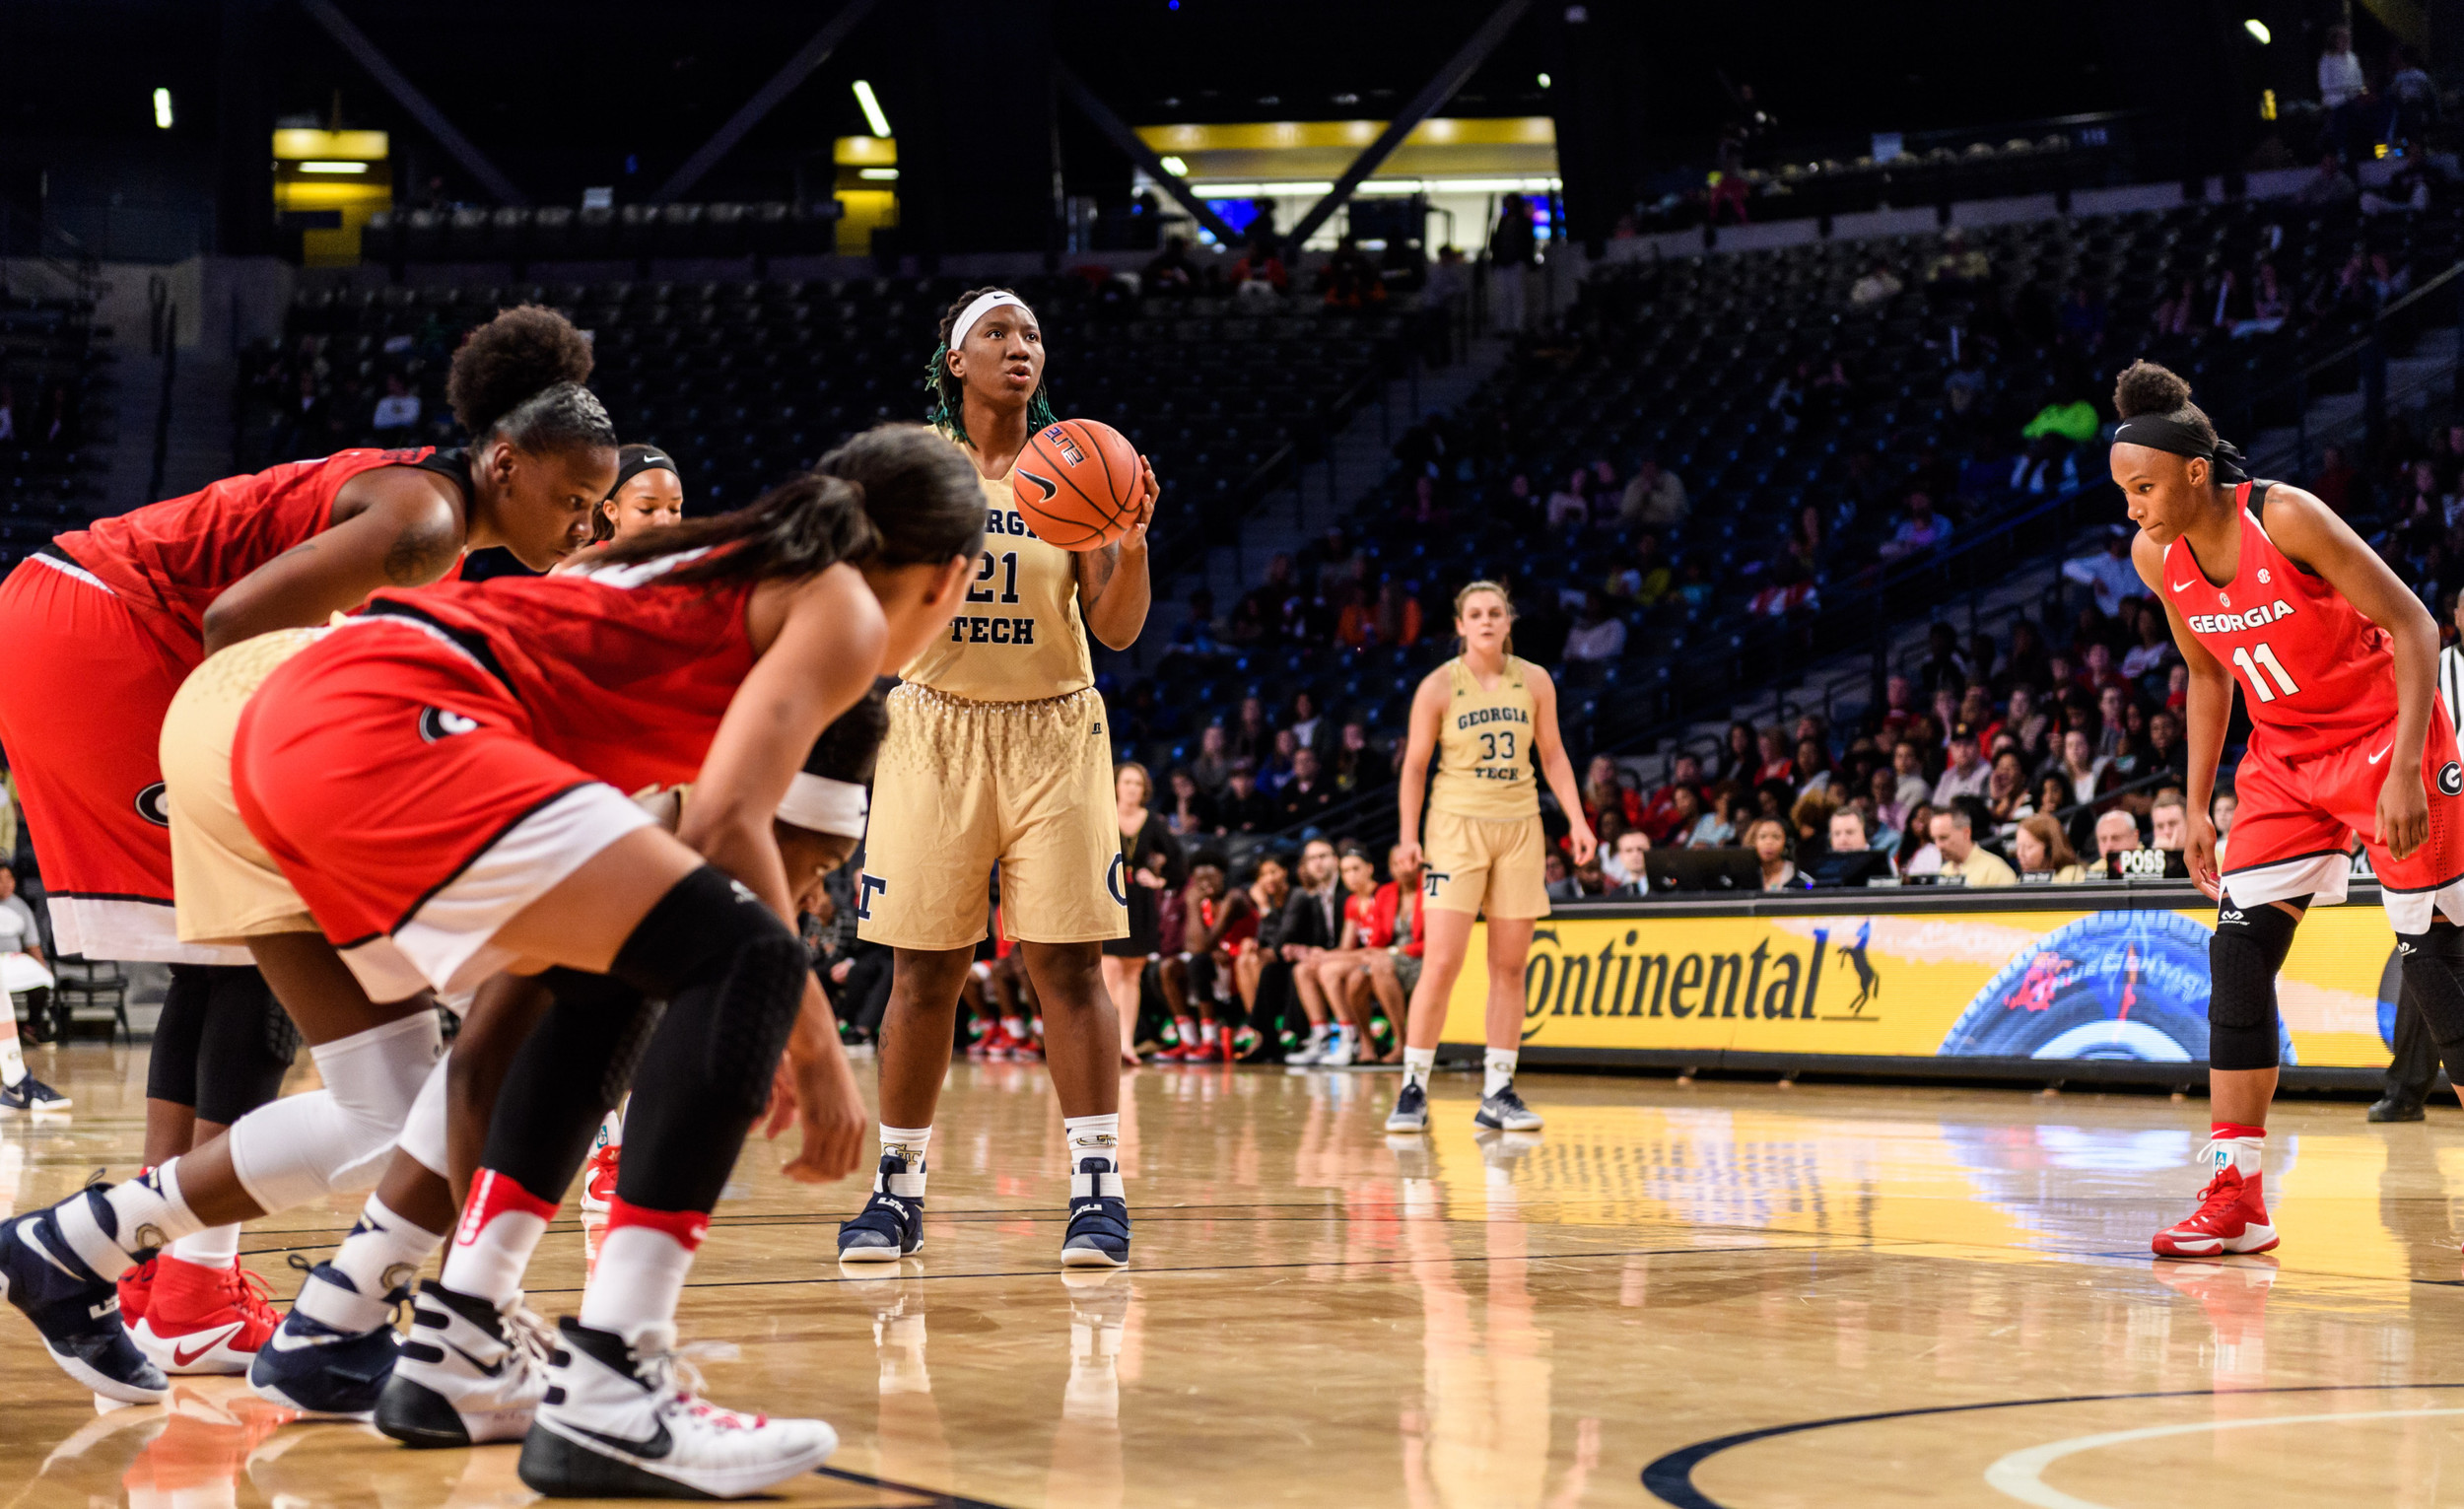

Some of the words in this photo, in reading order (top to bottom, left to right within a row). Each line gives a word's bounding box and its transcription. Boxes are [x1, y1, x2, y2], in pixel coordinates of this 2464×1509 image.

[1044, 426, 1085, 468] ELITE
[965, 551, 1019, 604] 21
[951, 616, 1035, 645] TECH
[2188, 599, 2296, 634] GEORGIA
[2232, 642, 2301, 703] 11
[1458, 707, 1529, 729] GEORGIA
[1479, 731, 1515, 761] 33
[1474, 767, 1519, 781] TECH
[2121, 849, 2165, 874] POSS
